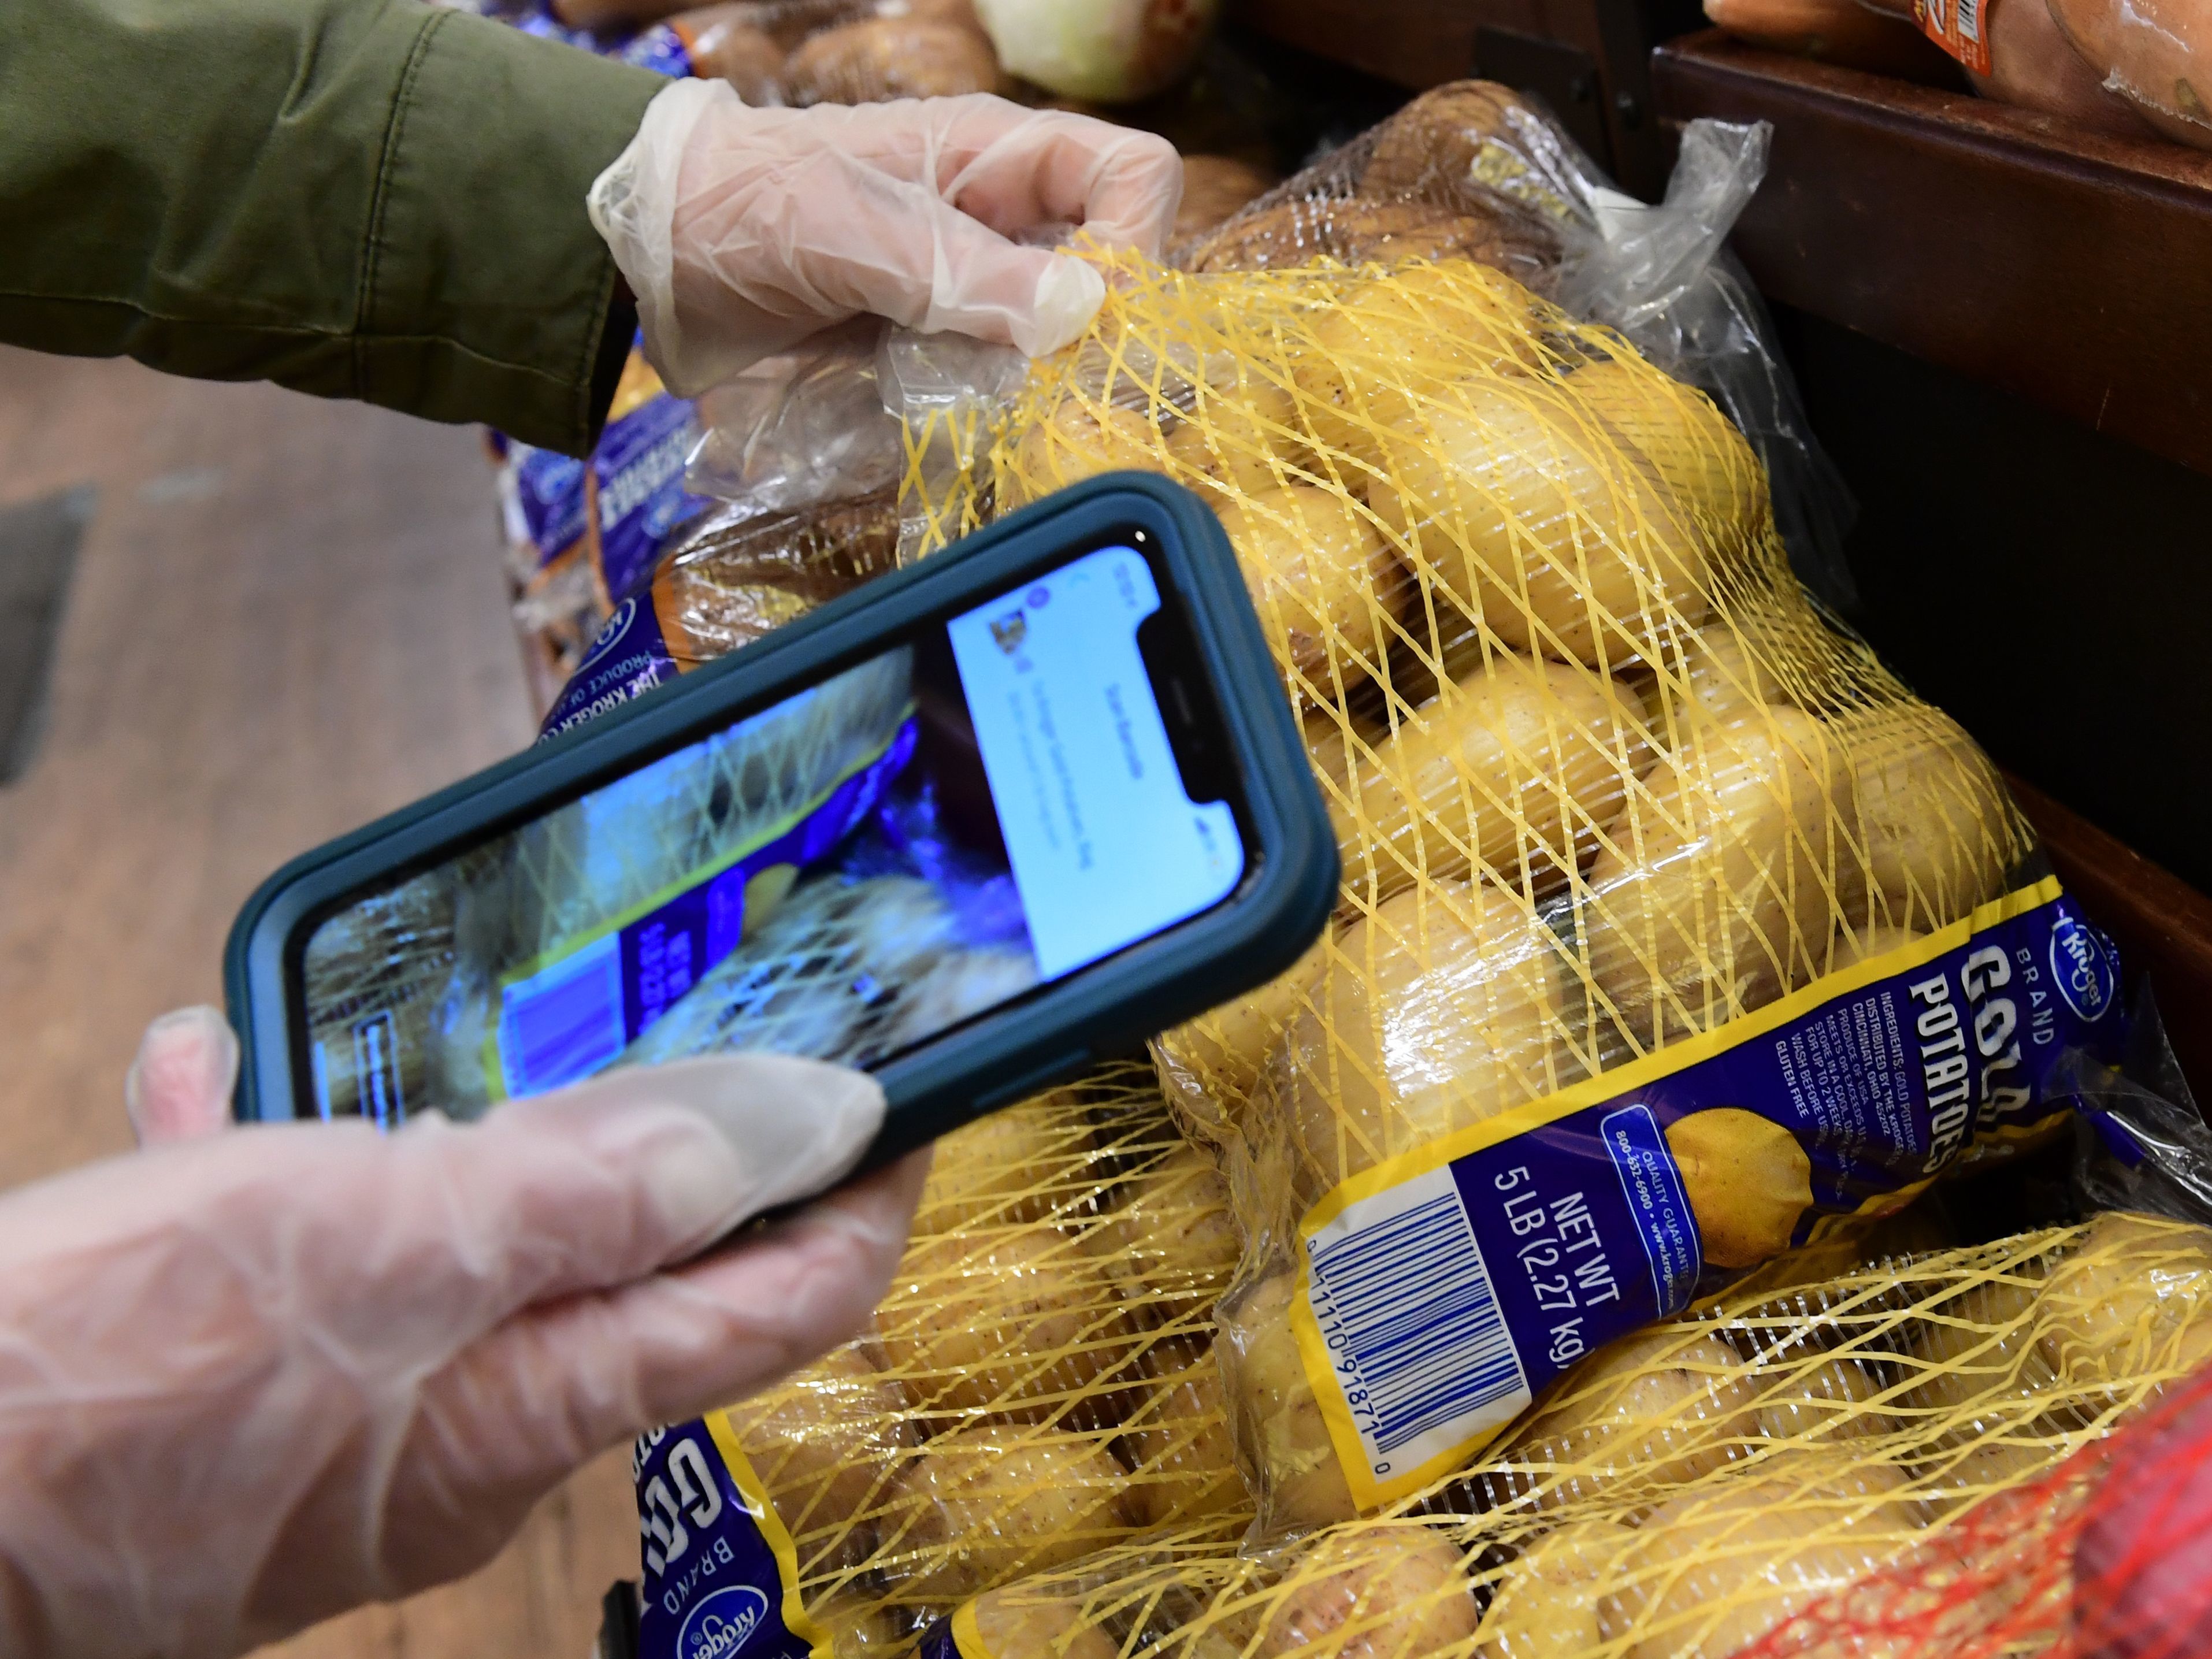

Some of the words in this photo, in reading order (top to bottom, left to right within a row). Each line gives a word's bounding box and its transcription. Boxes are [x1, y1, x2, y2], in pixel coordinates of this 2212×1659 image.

[588, 650, 653, 695] PRODUCE
[2062, 931, 2101, 1006] Kroger
[2016, 948, 2054, 1045] BRAND
[1805, 1026, 1817, 1051] FOR
[1814, 1021, 1833, 1059] STORE
[1838, 1008, 1858, 1063] PRODUCE
[1853, 1063, 1862, 1078] OF
[1858, 1079, 1869, 1105] USA
[1865, 997, 1887, 1070] DISTRIBUTED
[1880, 992, 1905, 1070] INGREDIENTS:
[1894, 1071, 1909, 1101] GOLD
[1961, 945, 2031, 1122] GOLD
[1775, 1040, 1797, 1088] GLUTEN
[1790, 1087, 1810, 1119] FREE
[1791, 1032, 1808, 1069] WASH
[1800, 1068, 1824, 1115] BEFORE
[1812, 1051, 1824, 1071] UP
[1816, 1070, 1829, 1085] TO
[1826, 1014, 1843, 1055] MEETS
[1839, 1056, 1849, 1073] OR
[1844, 1074, 1865, 1126] EXCEEDS
[1827, 1060, 1837, 1074] IN
[1831, 1075, 1840, 1085] A
[1853, 1003, 1873, 1071] CINCINNATI,
[1867, 1071, 1881, 1099] OHIO
[1876, 1101, 1891, 1137] 45202
[1879, 1072, 1890, 1088] BY
[1909, 971, 1969, 1174] POTATOES
[1821, 1086, 1832, 1096] 2
[1834, 1085, 1849, 1120] COOL,
[1883, 1089, 1895, 1112] THE
[1495, 1166, 1530, 1190] 5
[1642, 1151, 1669, 1204] QUALITY
[1504, 1190, 1545, 1235] LB
[1550, 1192, 1601, 1253] NET
[1616, 1130, 1653, 1209] 800-632-6900
[1651, 1222, 1673, 1310] www.krog
[1307, 1239, 1317, 1252] 0
[1517, 1238, 1576, 1311] (2.27
[1574, 1253, 1620, 1307] WT
[1311, 1278, 1348, 1351] 11110
[1549, 1317, 1595, 1369] kg)
[1337, 1359, 1380, 1434] 91871
[1375, 1462, 1391, 1475] 0
[664, 1535, 734, 1615] BRAND
